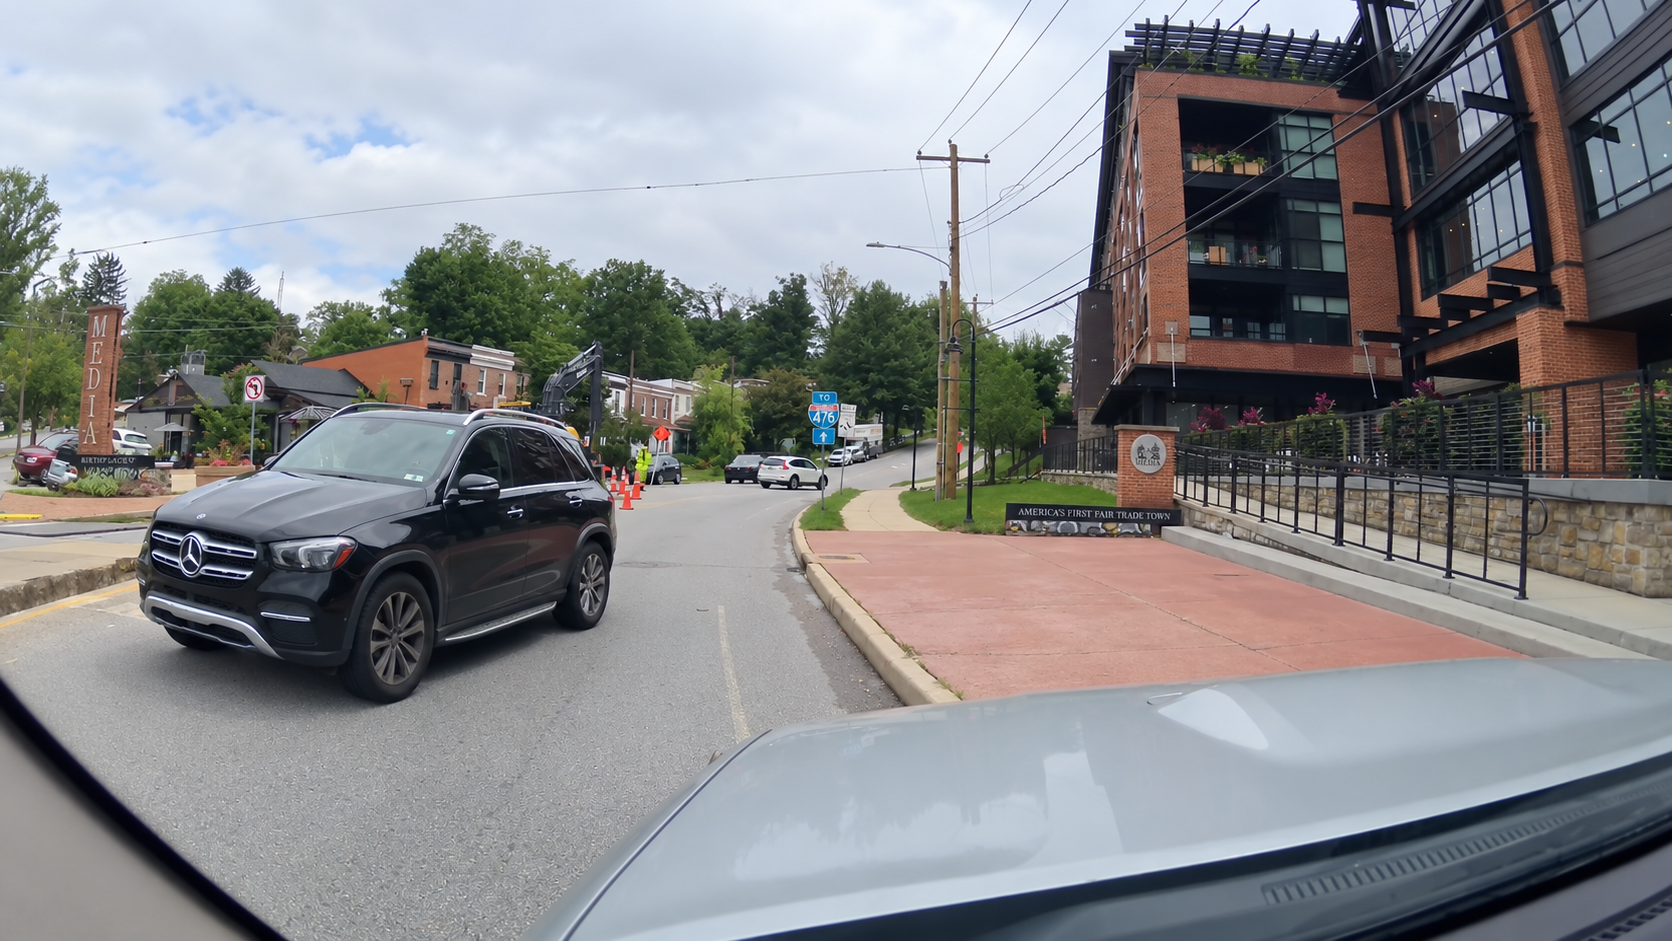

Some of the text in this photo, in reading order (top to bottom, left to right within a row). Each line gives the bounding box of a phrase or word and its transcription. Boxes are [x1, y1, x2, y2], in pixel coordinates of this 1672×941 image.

[83, 314, 108, 445] MEDIA
[819, 394, 830, 402] TO
[812, 410, 835, 425] 476
[1018, 507, 1171, 520] AMERICA'S FIRST FAIR TRADE TOWN
